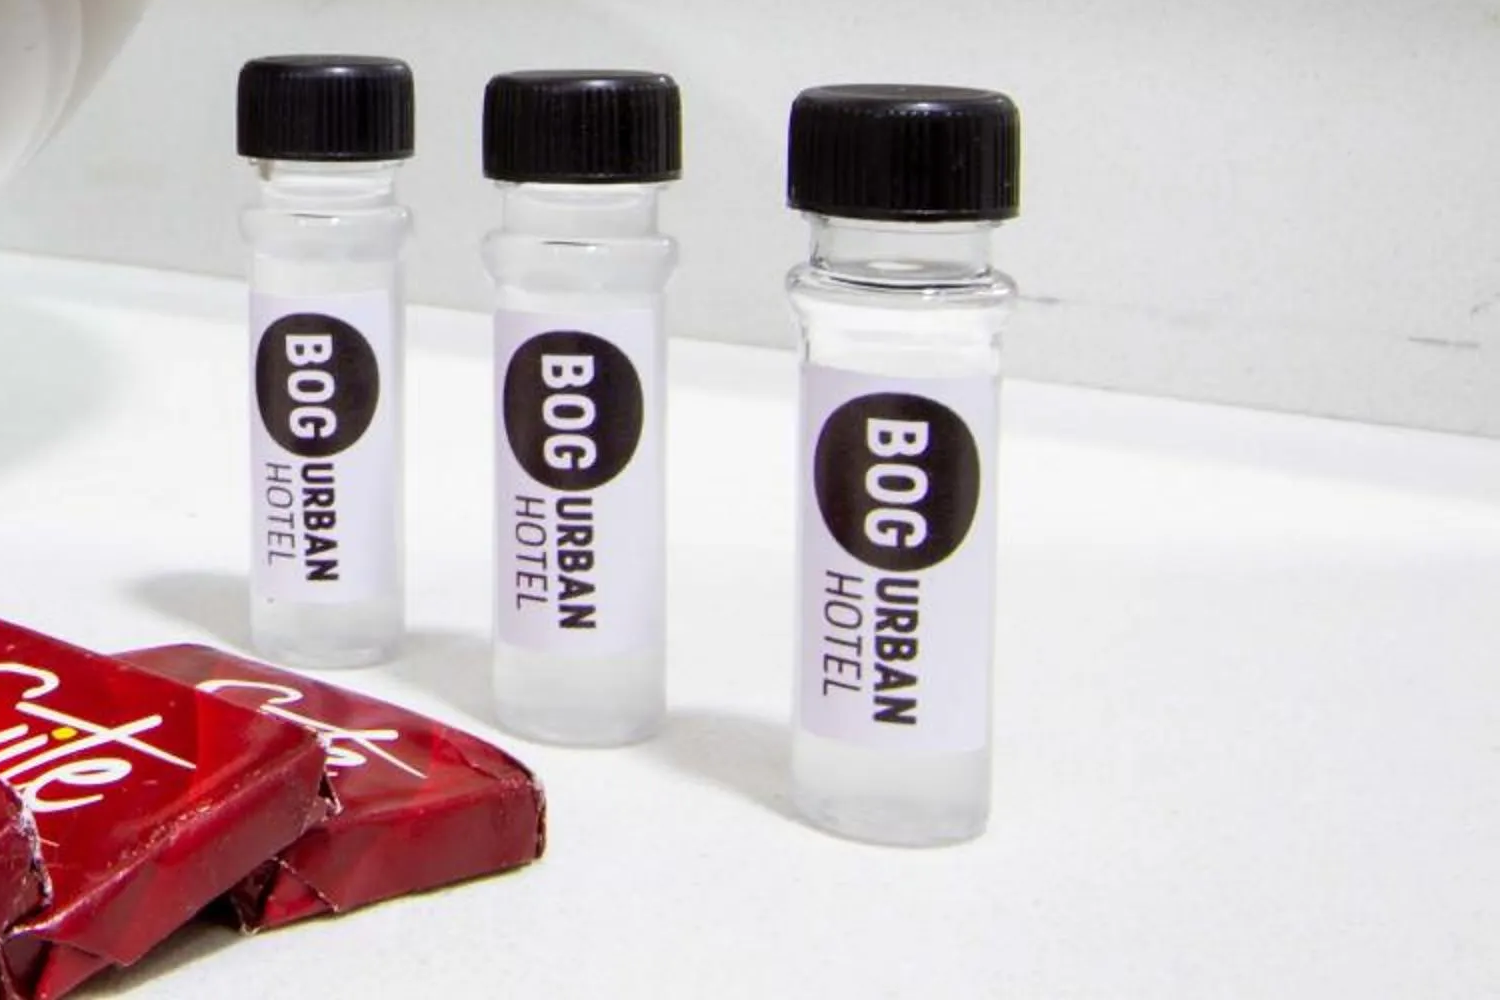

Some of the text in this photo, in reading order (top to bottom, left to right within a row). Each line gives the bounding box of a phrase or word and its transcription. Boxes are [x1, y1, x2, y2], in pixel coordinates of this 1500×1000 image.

[285, 333, 338, 440] BOG
[541, 354, 598, 472] BOG
[264, 461, 296, 566] HOTEL
[300, 463, 340, 582] URBAN
[863, 417, 930, 549] BOG
[514, 495, 548, 610] HOTEL
[555, 496, 597, 630] URBAN
[822, 569, 864, 697] HOTEL
[872, 576, 920, 726] URBAN
